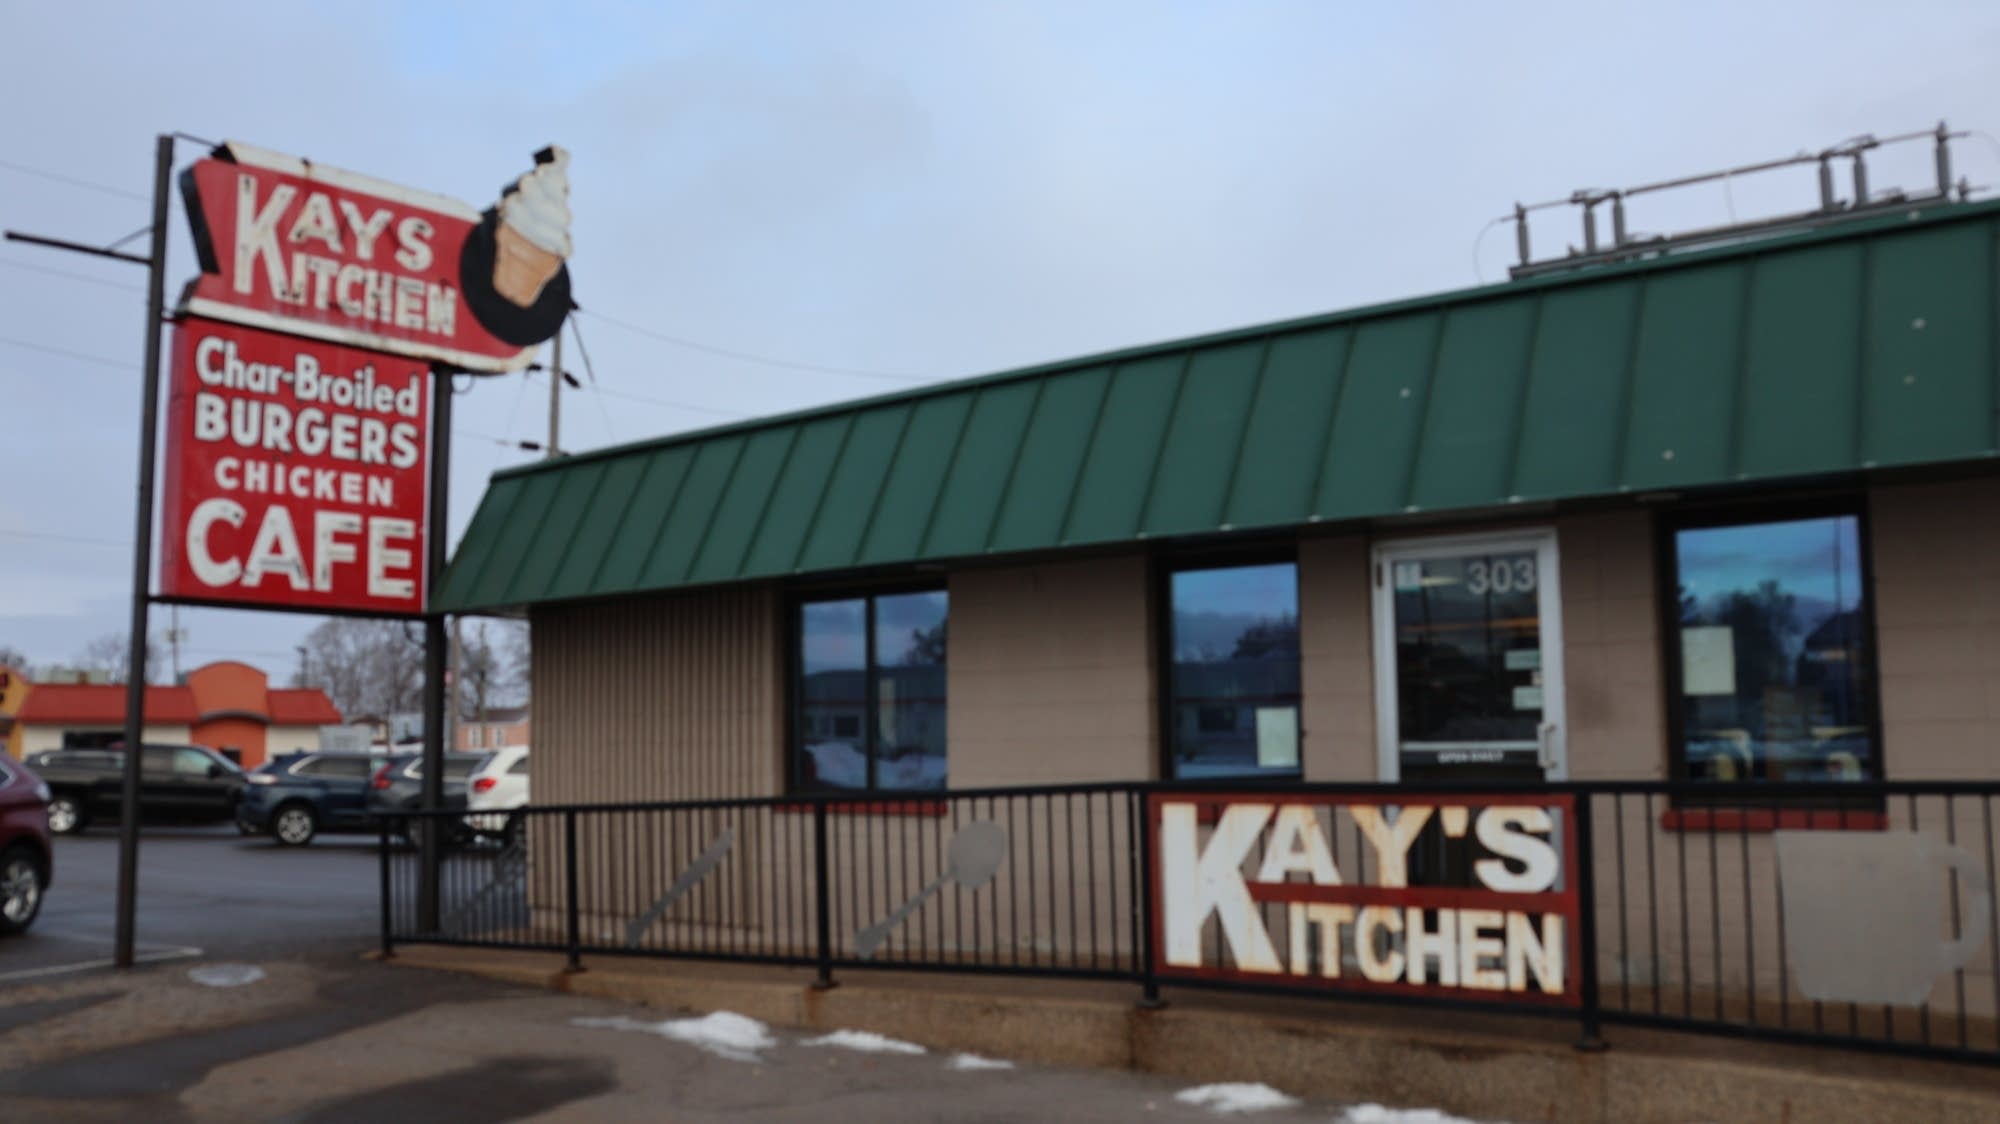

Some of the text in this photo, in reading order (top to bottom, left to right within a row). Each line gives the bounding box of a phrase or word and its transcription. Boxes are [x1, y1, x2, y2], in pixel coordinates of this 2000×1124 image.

[196, 335, 419, 418] Char-Broiled
[194, 391, 418, 469] BURGERS
[214, 456, 393, 507] CHICKEN
[186, 497, 416, 599] CAFE
[1467, 558, 1537, 595] 303
[1160, 803, 1559, 973] KAY'S
